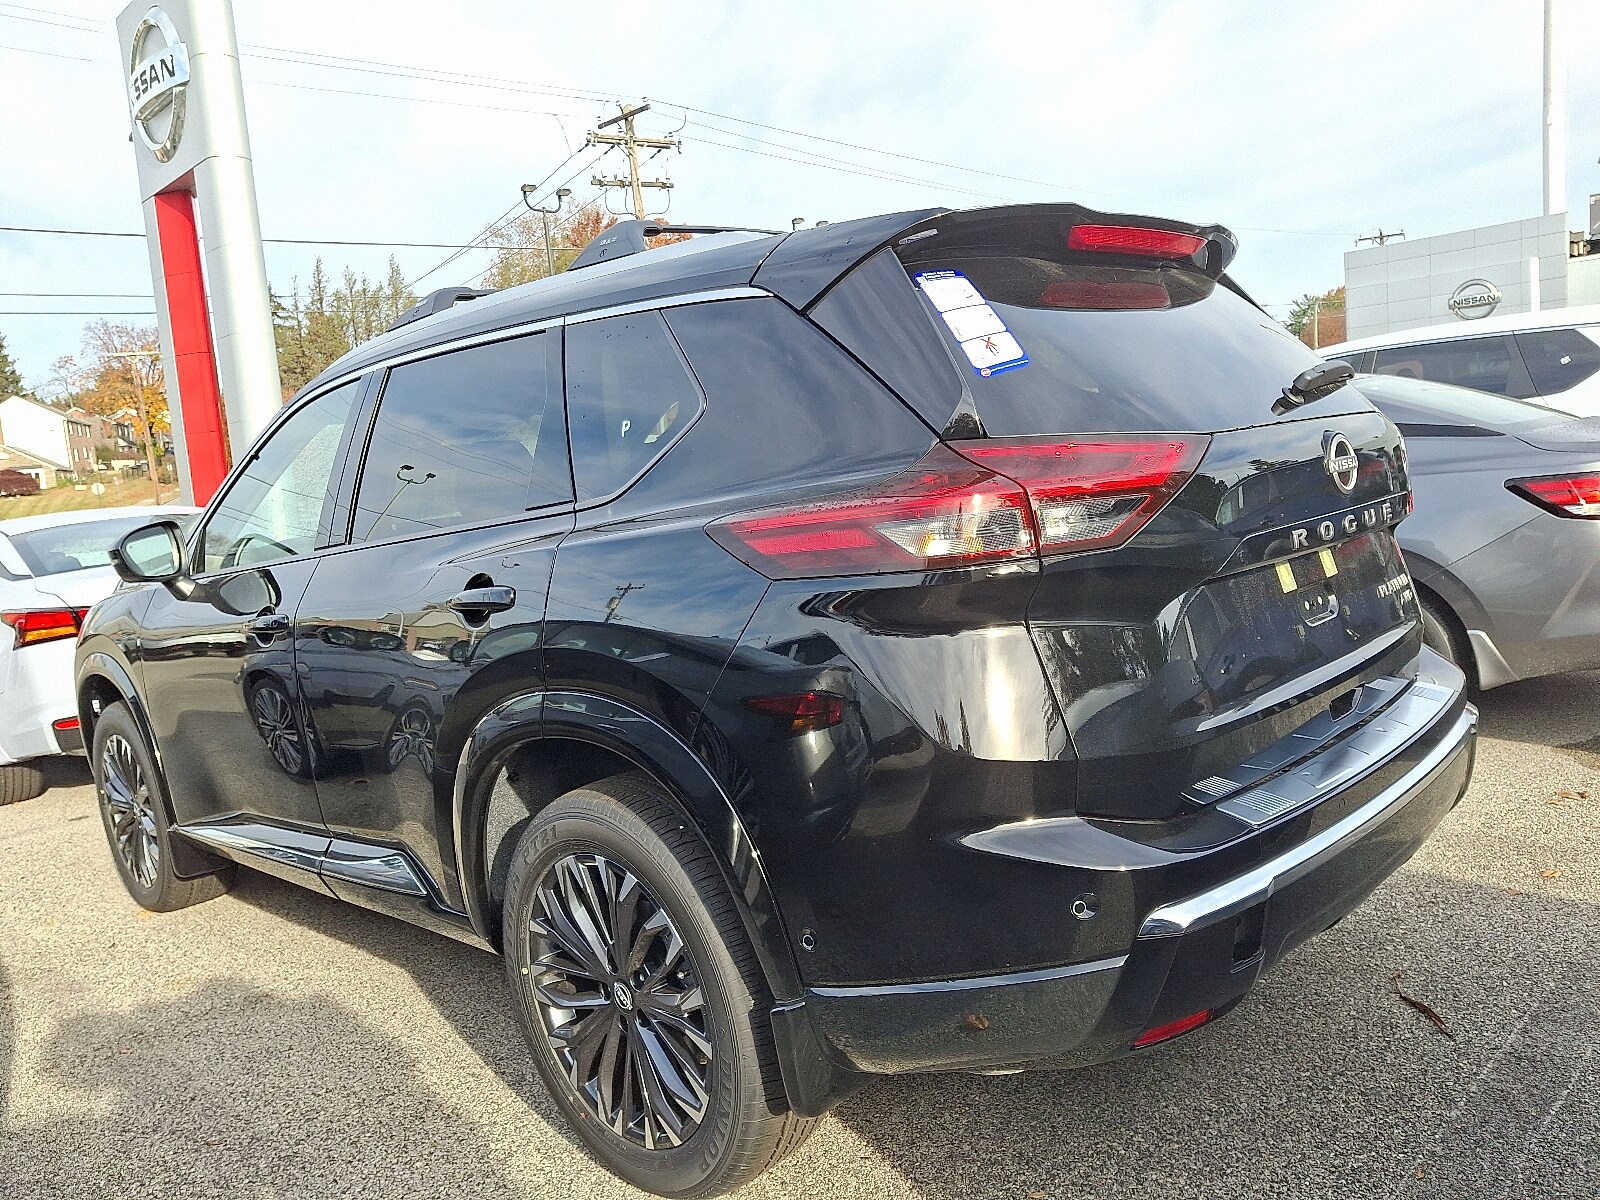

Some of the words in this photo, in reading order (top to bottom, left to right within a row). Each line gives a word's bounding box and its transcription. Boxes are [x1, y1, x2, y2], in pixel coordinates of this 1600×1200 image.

[131, 54, 175, 104] SSAN
[1453, 294, 1496, 307] NISSAN
[1330, 458, 1357, 471] NISSA
[1290, 502, 1393, 551] ROGUE
